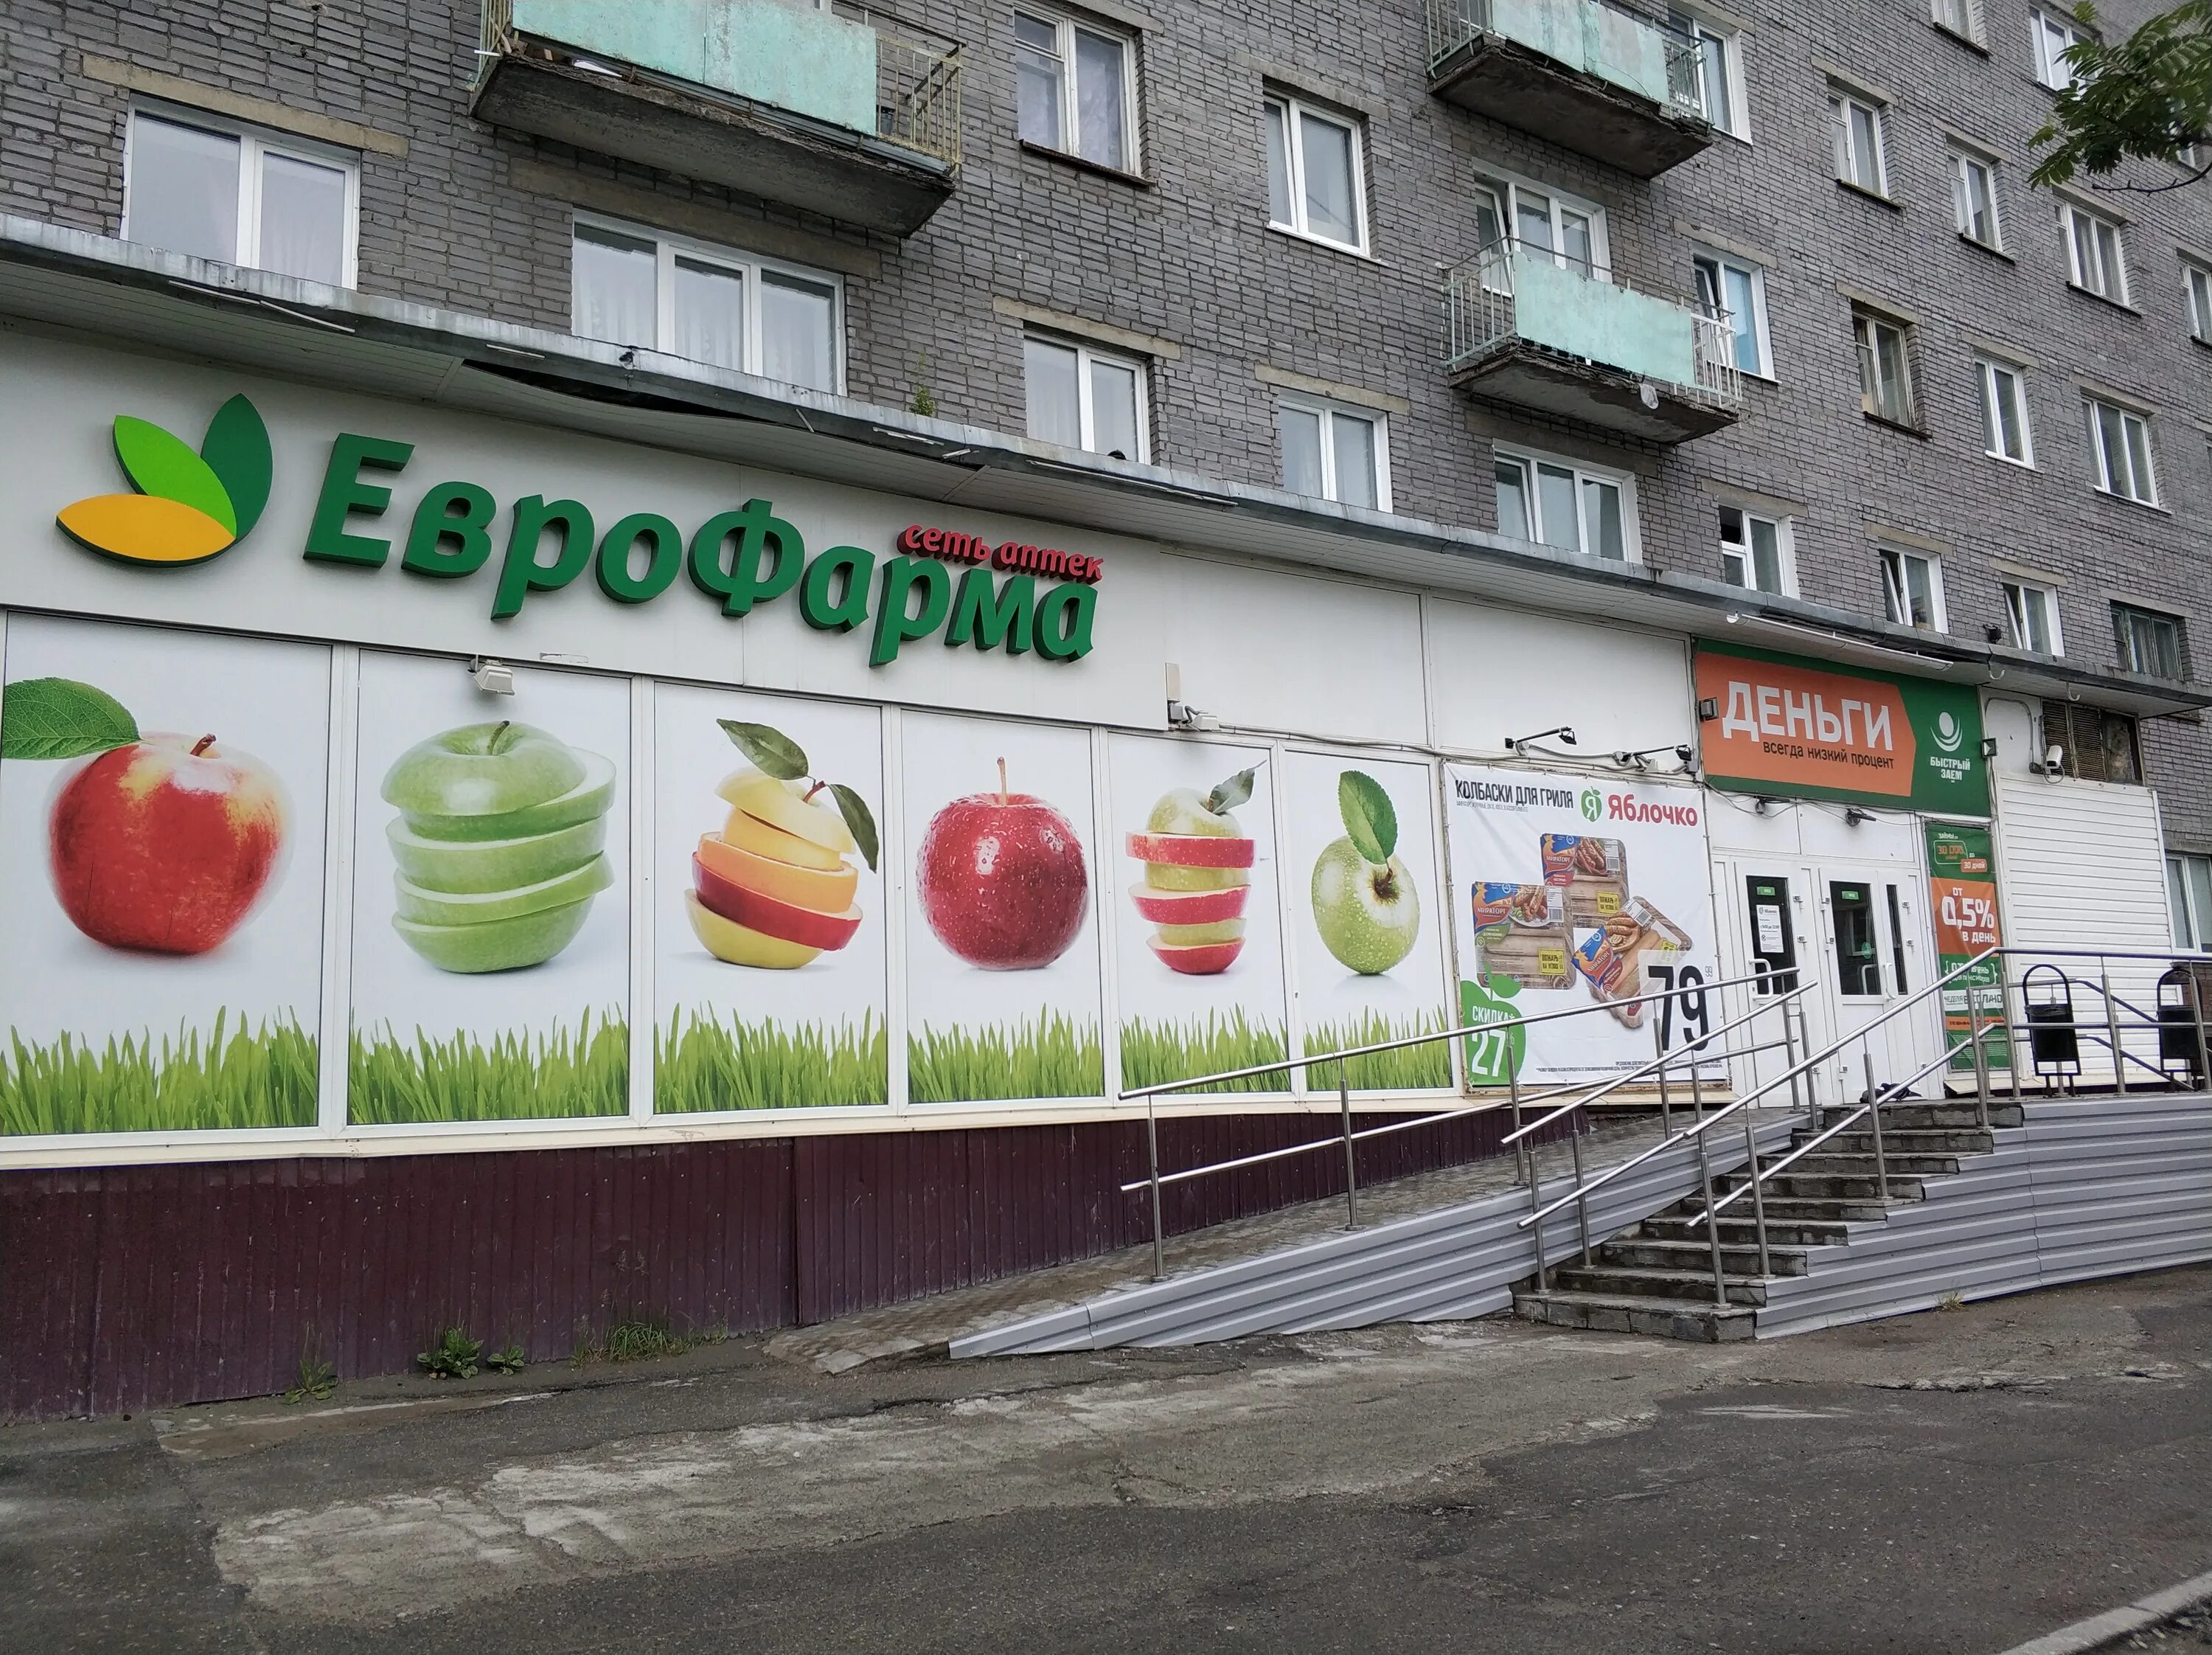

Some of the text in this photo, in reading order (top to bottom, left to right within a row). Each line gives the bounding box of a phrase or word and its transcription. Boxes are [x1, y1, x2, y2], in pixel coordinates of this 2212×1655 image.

[303, 432, 1099, 667] ЕвроФарма
[897, 524, 1104, 585] сеть аптек
[1722, 681, 1893, 751] ДЕНЬГИ
[1763, 742, 1893, 769] всегда низкий процент
[1930, 756, 1970, 771] БЫСТРЫЙ
[1941, 768, 1962, 780] ЗАЕМ
[1455, 780, 1573, 809] КОЛБАСКИ ДЛЯ ГРИЛЯ
[1608, 794, 1698, 827] Яблочко
[1941, 896, 1994, 929] 0,5%
[1972, 931, 1996, 944] день
[1587, 949, 1610, 971] МИРАТОРГ
[1648, 965, 1708, 1051] 79
